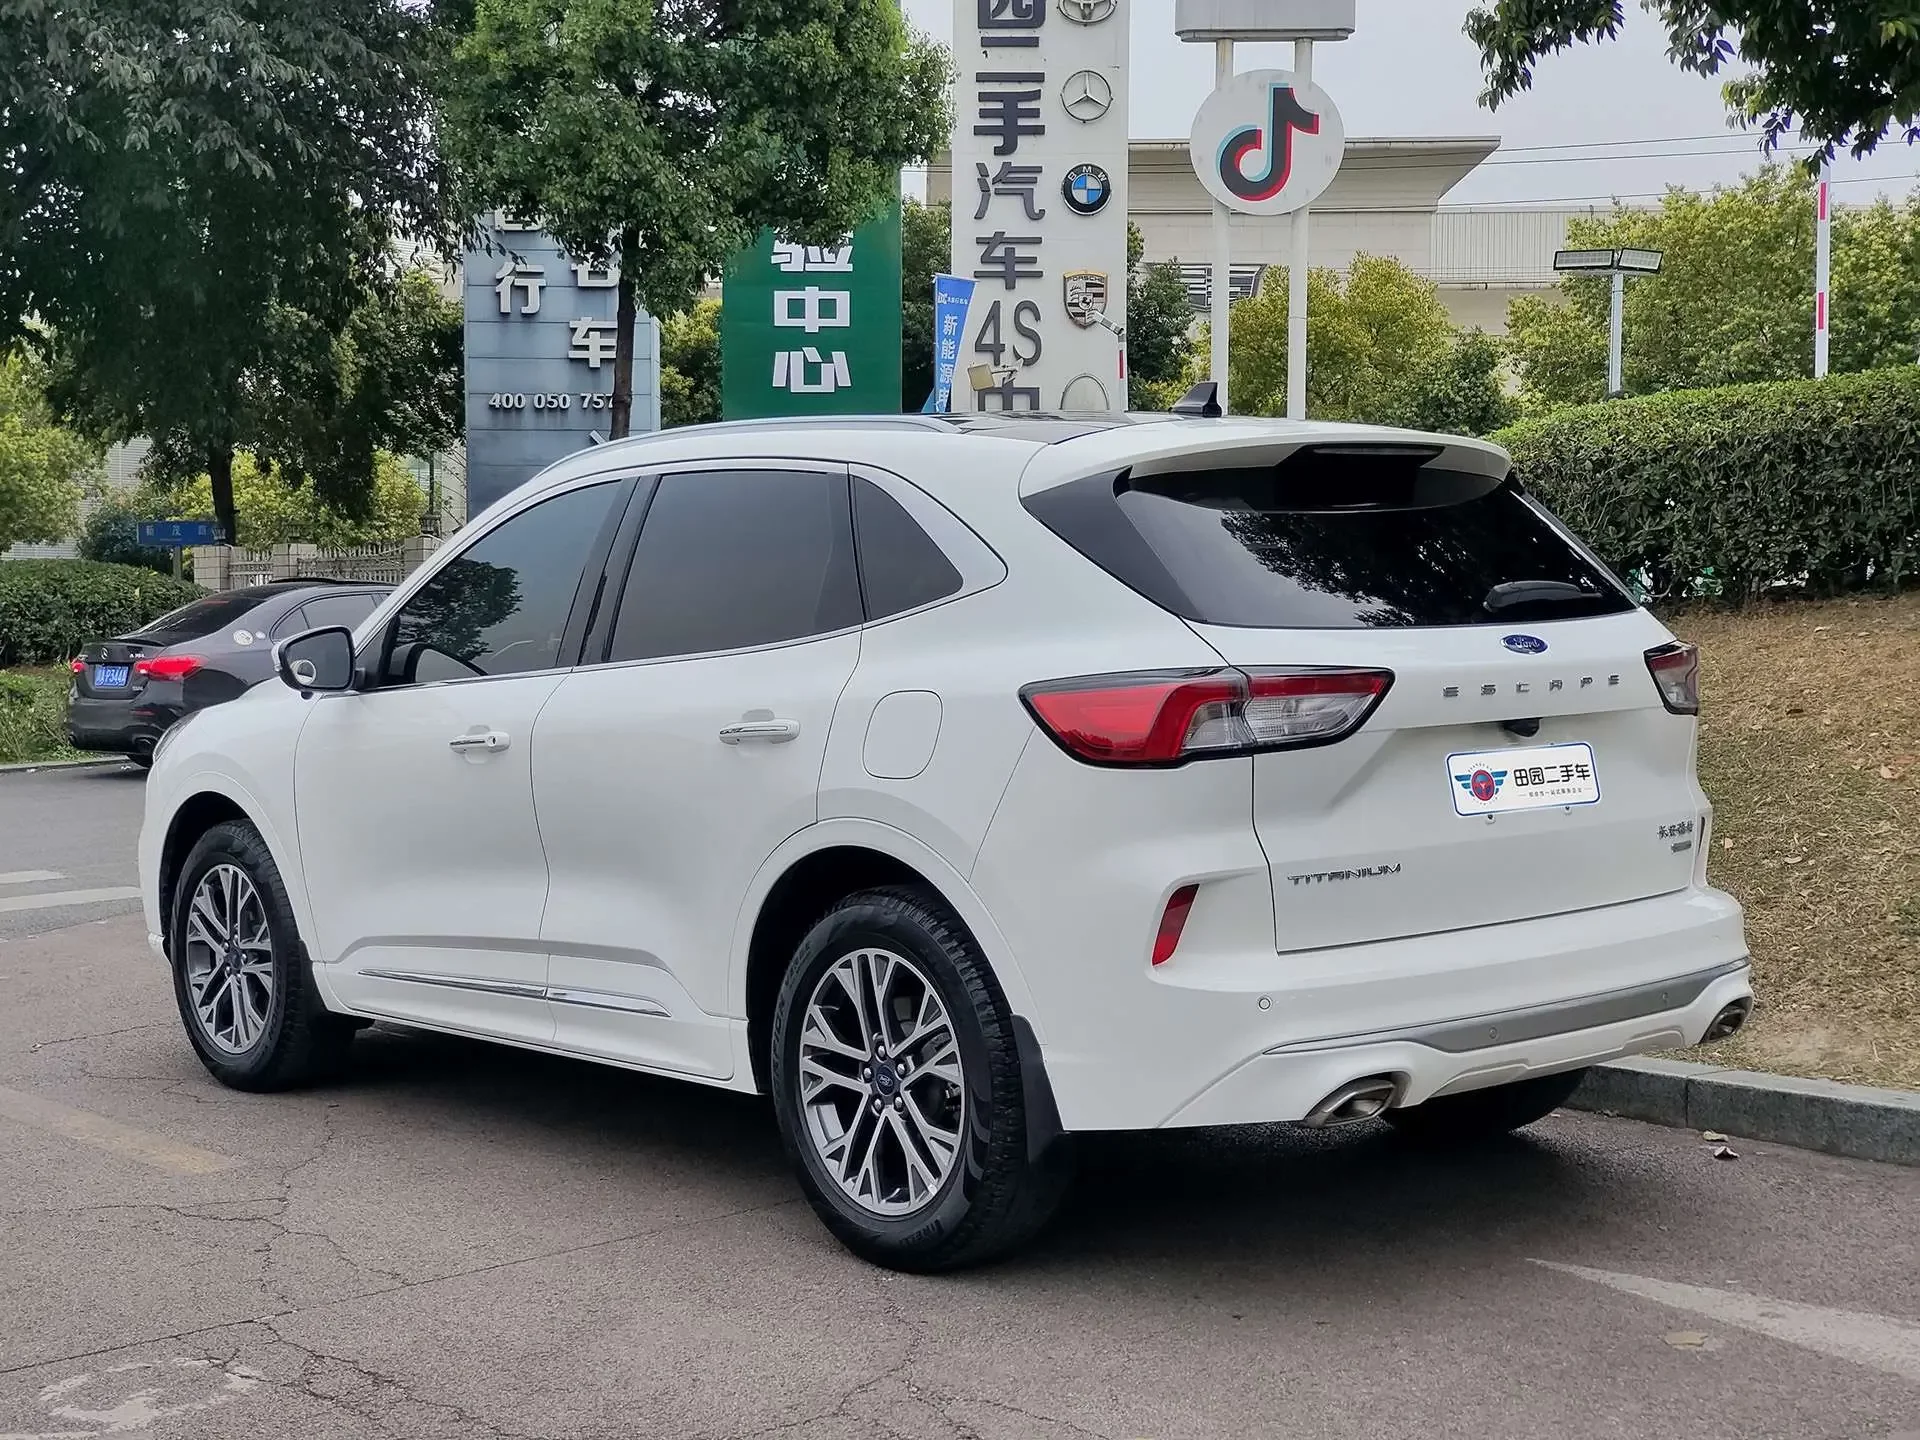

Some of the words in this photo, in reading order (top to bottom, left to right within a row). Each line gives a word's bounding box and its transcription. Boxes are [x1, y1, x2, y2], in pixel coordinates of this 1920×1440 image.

[1067, 165, 1107, 182] BMW
[488, 393, 526, 409] 400
[533, 393, 571, 409] 050
[1512, 637, 1541, 648] Ford
[1443, 674, 1620, 698] ESCAPE
[1513, 764, 1591, 787] 田园二手车
[1288, 864, 1401, 885] TITANIUM
